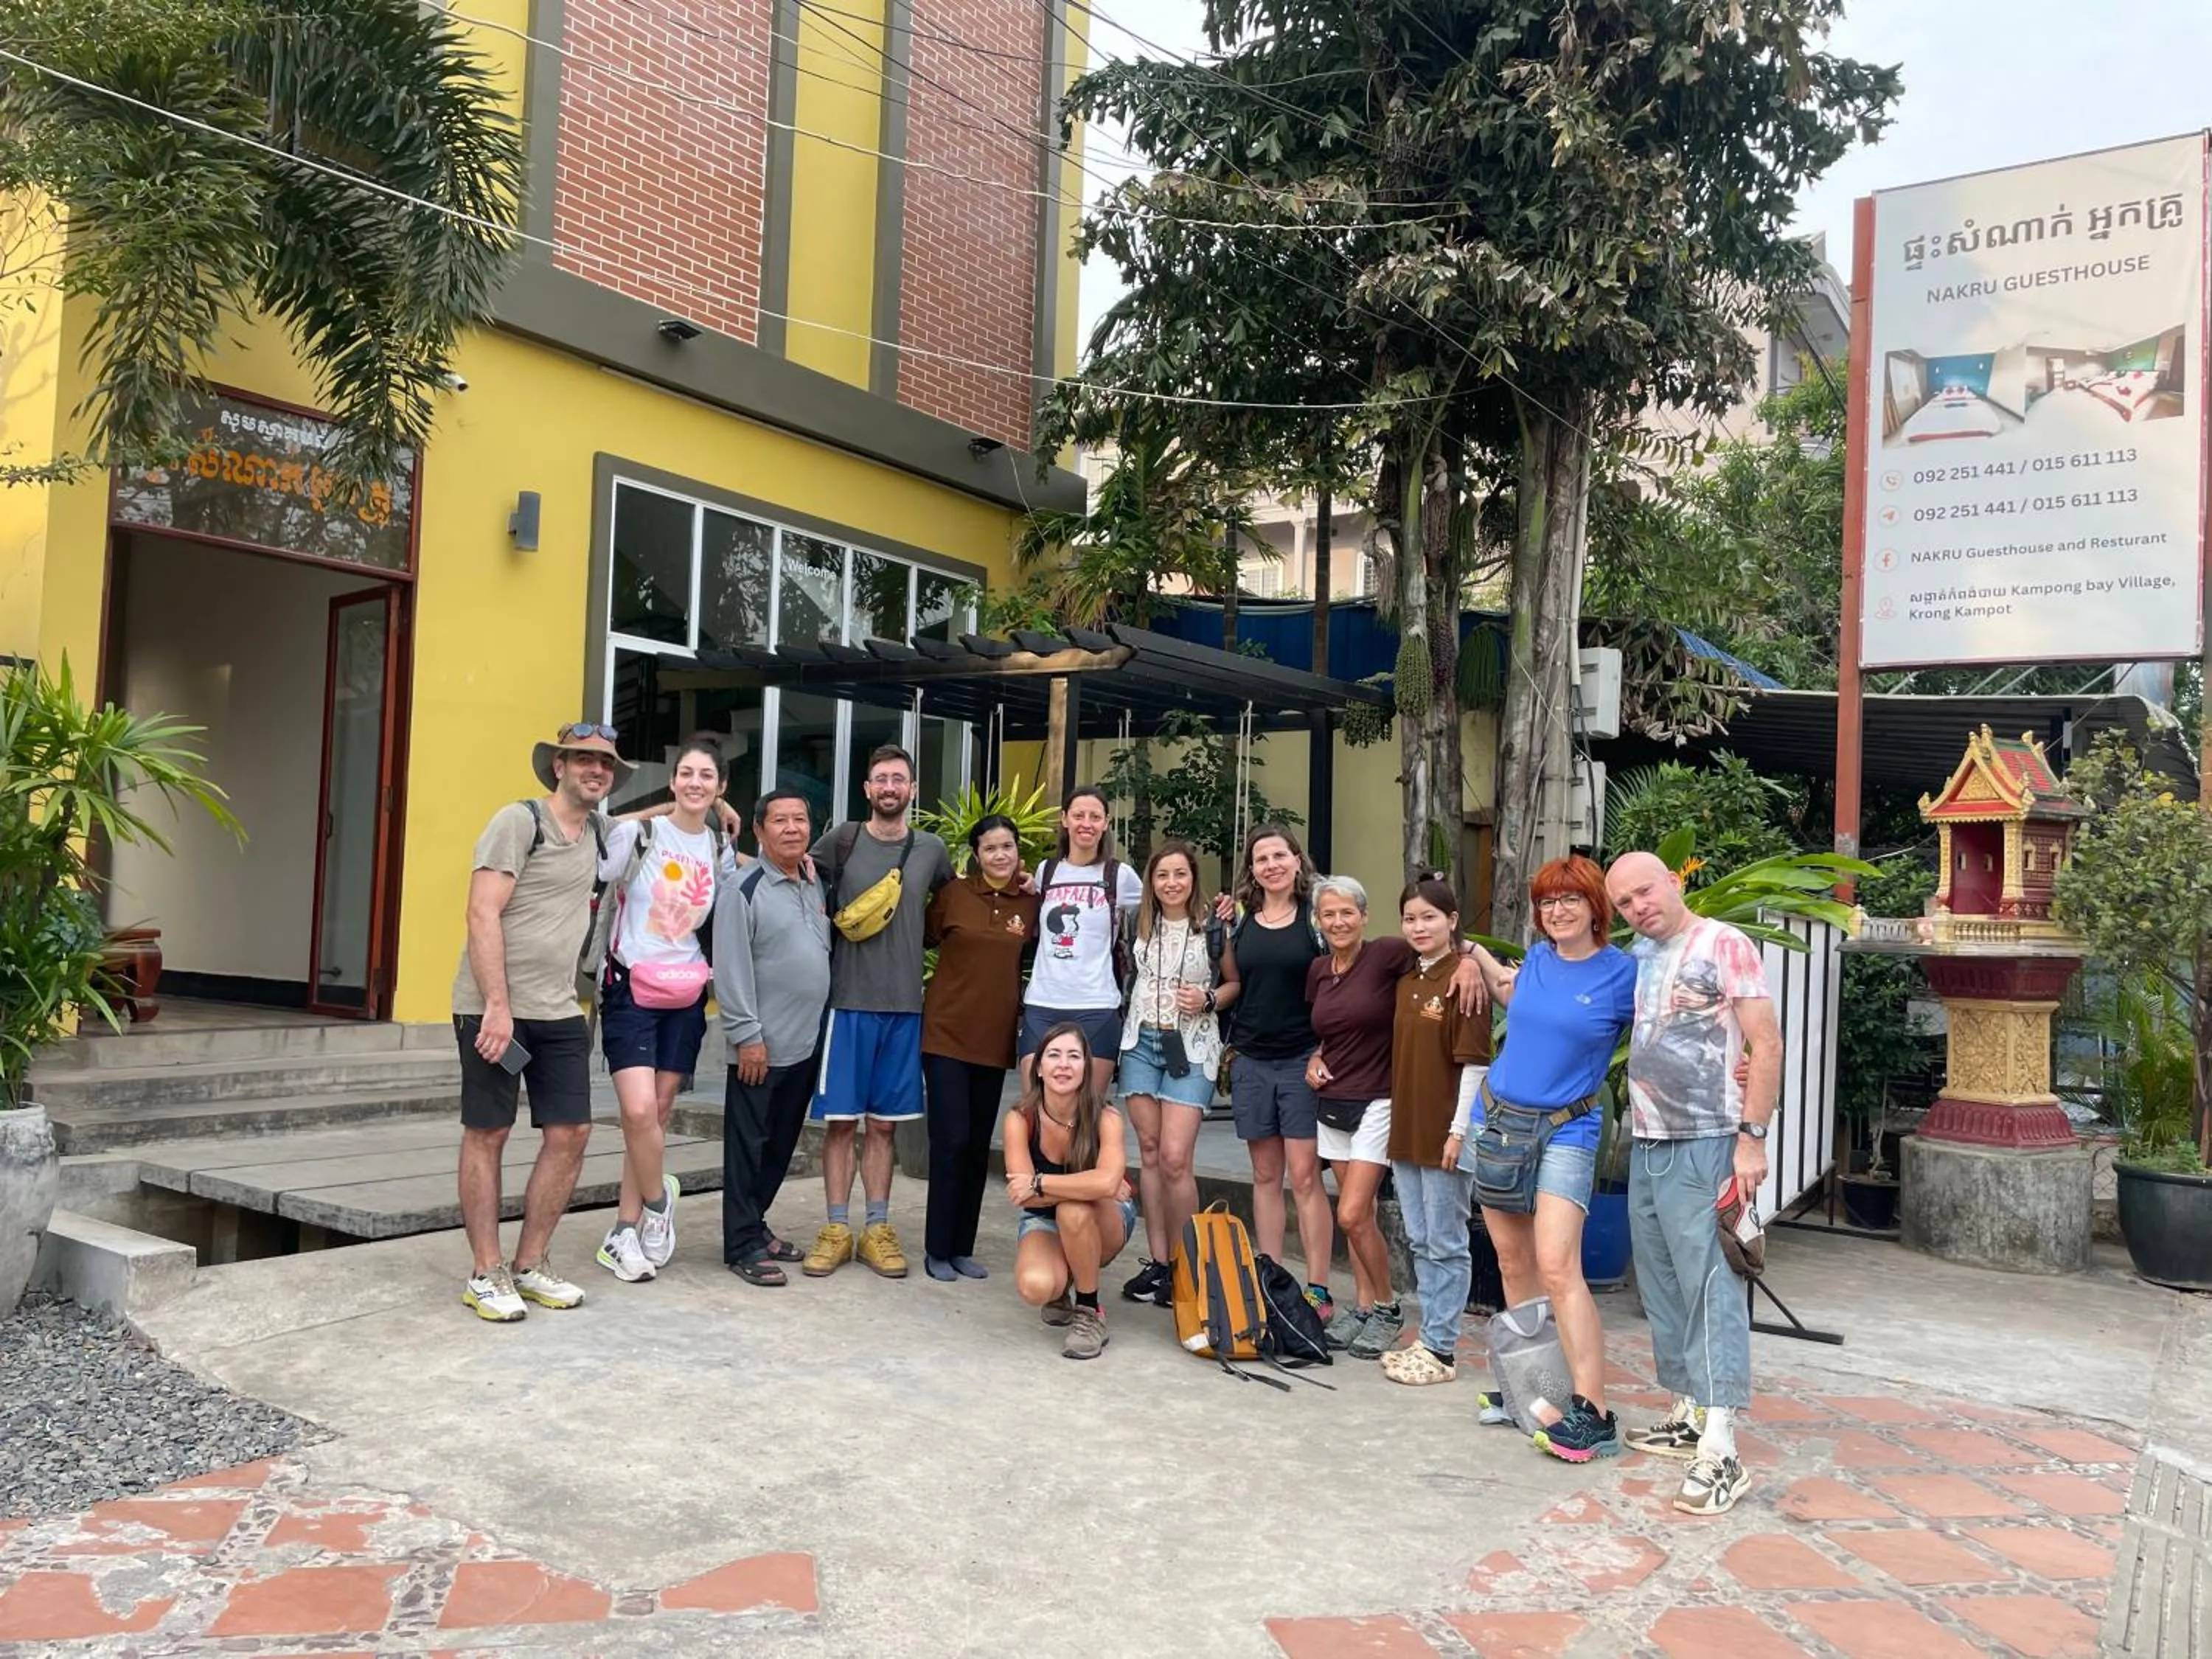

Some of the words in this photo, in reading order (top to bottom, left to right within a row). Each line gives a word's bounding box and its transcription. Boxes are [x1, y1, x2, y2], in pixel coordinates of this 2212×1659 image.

[1902, 204, 2073, 271] ផ្ទះសំណាក់
[2087, 192, 2184, 240] អ្នកគ្រូ
[1927, 279, 1997, 303] NAKRU
[2003, 254, 2151, 293] GUESTHOUSE
[1913, 469, 1946, 484] 092
[1950, 466, 1978, 481] 251
[1984, 462, 2016, 477] 441
[2020, 459, 2028, 475] /
[2032, 456, 2065, 472] 015
[2070, 453, 2101, 467] 611
[2105, 448, 2138, 465] 113
[1913, 507, 1946, 522] 092
[1950, 504, 1979, 519] 251
[1984, 501, 2016, 515] 441
[2020, 498, 2028, 514] /
[2032, 495, 2065, 511] 015
[2070, 492, 2101, 507] 611
[2105, 488, 2138, 504] 113
[1910, 549, 1962, 563] NAKRU
[1966, 542, 2053, 560] Guesthouse
[2057, 538, 2086, 552] and
[2090, 532, 2168, 549] Resturant
[787, 559, 837, 580] Welcome
[2011, 580, 2082, 598] Kampong
[2086, 577, 2114, 594] bay
[2118, 574, 2177, 590] Village,
[1909, 606, 1951, 621] Krong
[1954, 603, 2013, 619] Kampot
